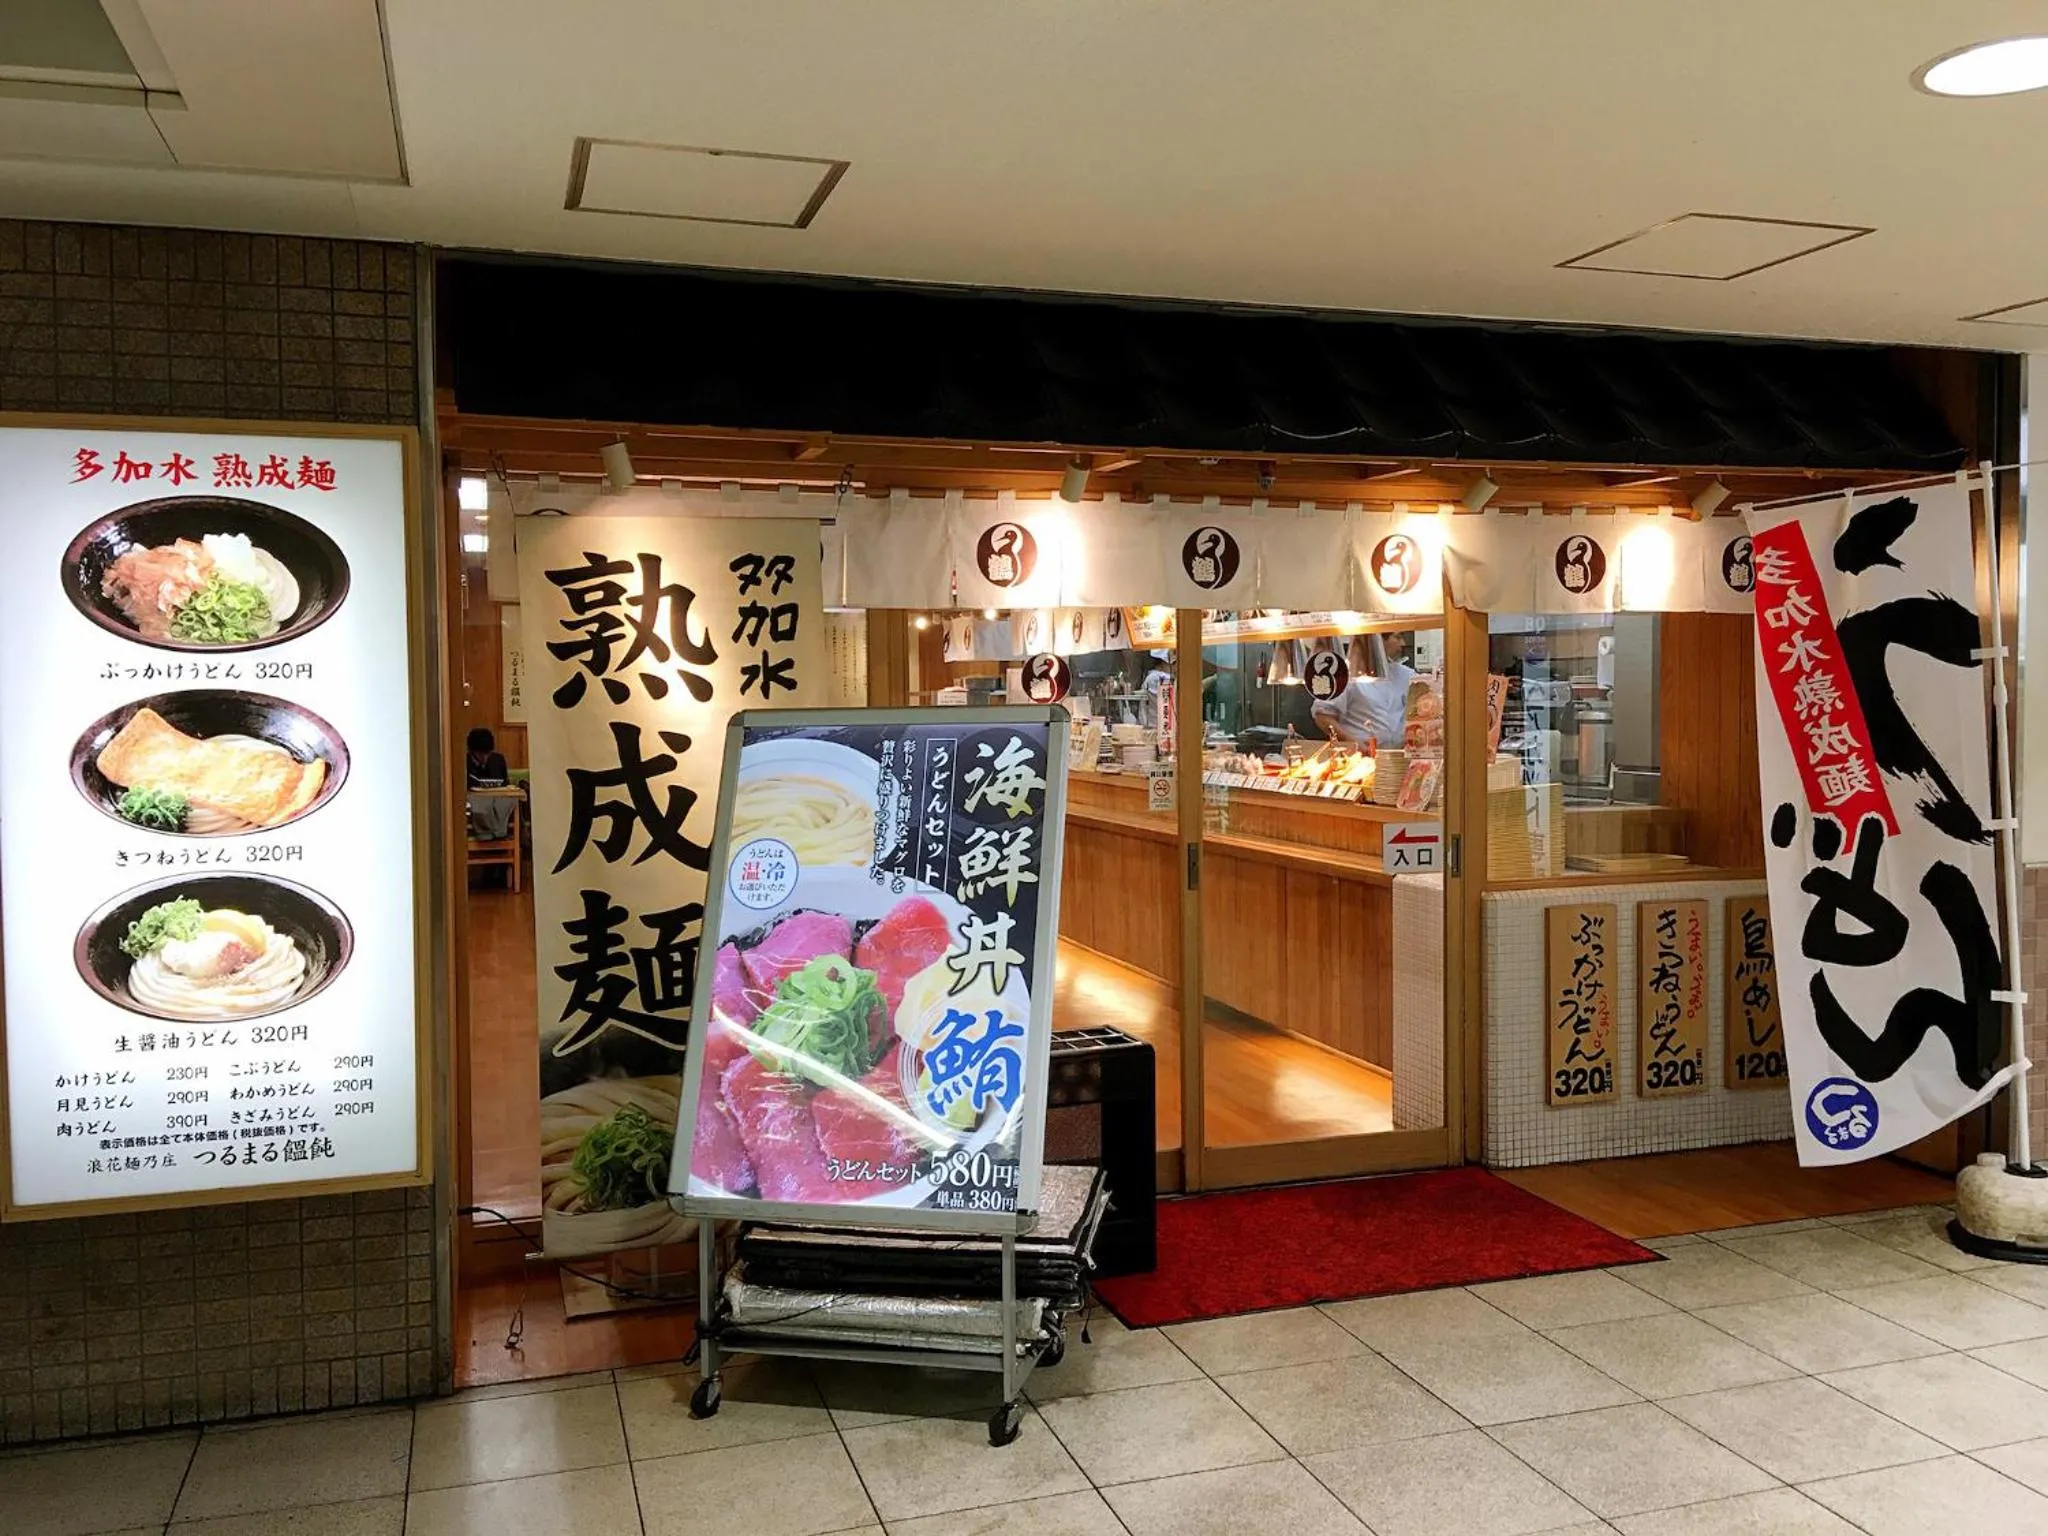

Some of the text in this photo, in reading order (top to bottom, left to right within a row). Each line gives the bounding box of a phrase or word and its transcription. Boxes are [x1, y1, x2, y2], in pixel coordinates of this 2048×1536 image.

[68, 447, 339, 492] 多加水 熟成麺
[100, 662, 313, 680] ぶっかけうどん 320円
[925, 746, 950, 885] うどんセット
[114, 845, 303, 867] きつねうどん 320円
[945, 737, 1047, 997] 海鮮丼
[1393, 848, 1434, 867] 入口
[114, 1025, 309, 1053] 生醤油うどん 320円
[228, 1055, 374, 1077] こぶうどん 290円
[922, 1008, 1027, 1117] 鮪
[55, 1066, 209, 1088] かけうどん 230円
[230, 1078, 373, 1100] わかめうどん 290円
[57, 1090, 209, 1113] 月見うどん 290円
[230, 1102, 375, 1124] きざみうどん 290円
[56, 1114, 208, 1137] 肉うどん 390円
[193, 1136, 336, 1166] つるまる饂飩
[827, 1158, 921, 1184] うどんセット
[928, 1151, 1013, 1187] 580円
[937, 1189, 1014, 1211] 単品 380円
